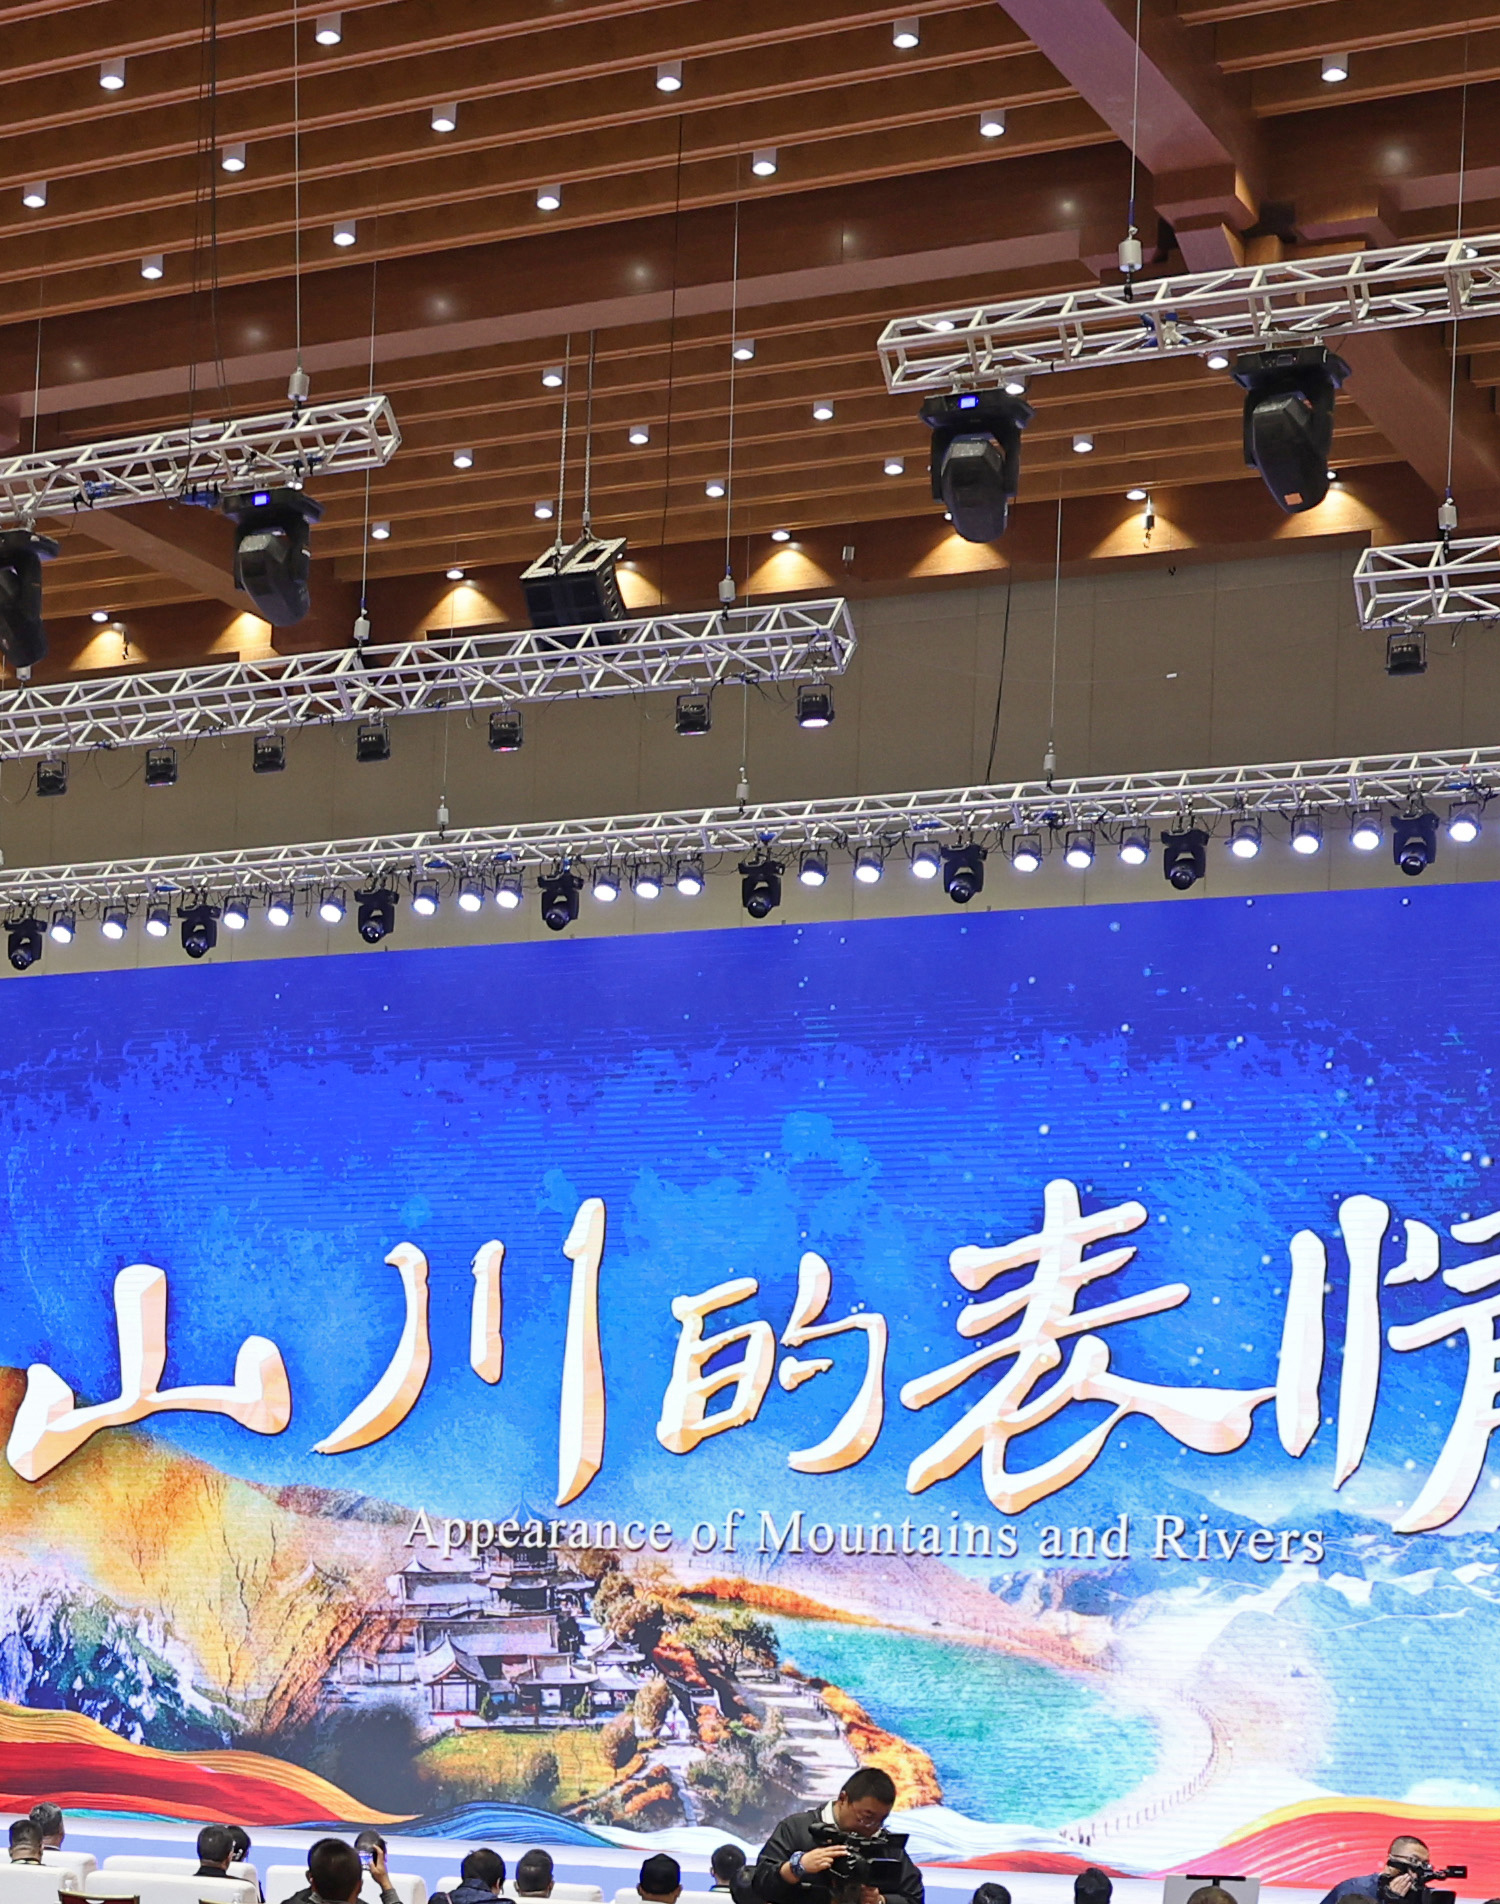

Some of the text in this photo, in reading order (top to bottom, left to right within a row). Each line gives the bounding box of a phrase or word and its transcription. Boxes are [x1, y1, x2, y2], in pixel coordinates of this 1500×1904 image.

[403, 1504, 1327, 1564] Appearance of Mountains and Rivers
